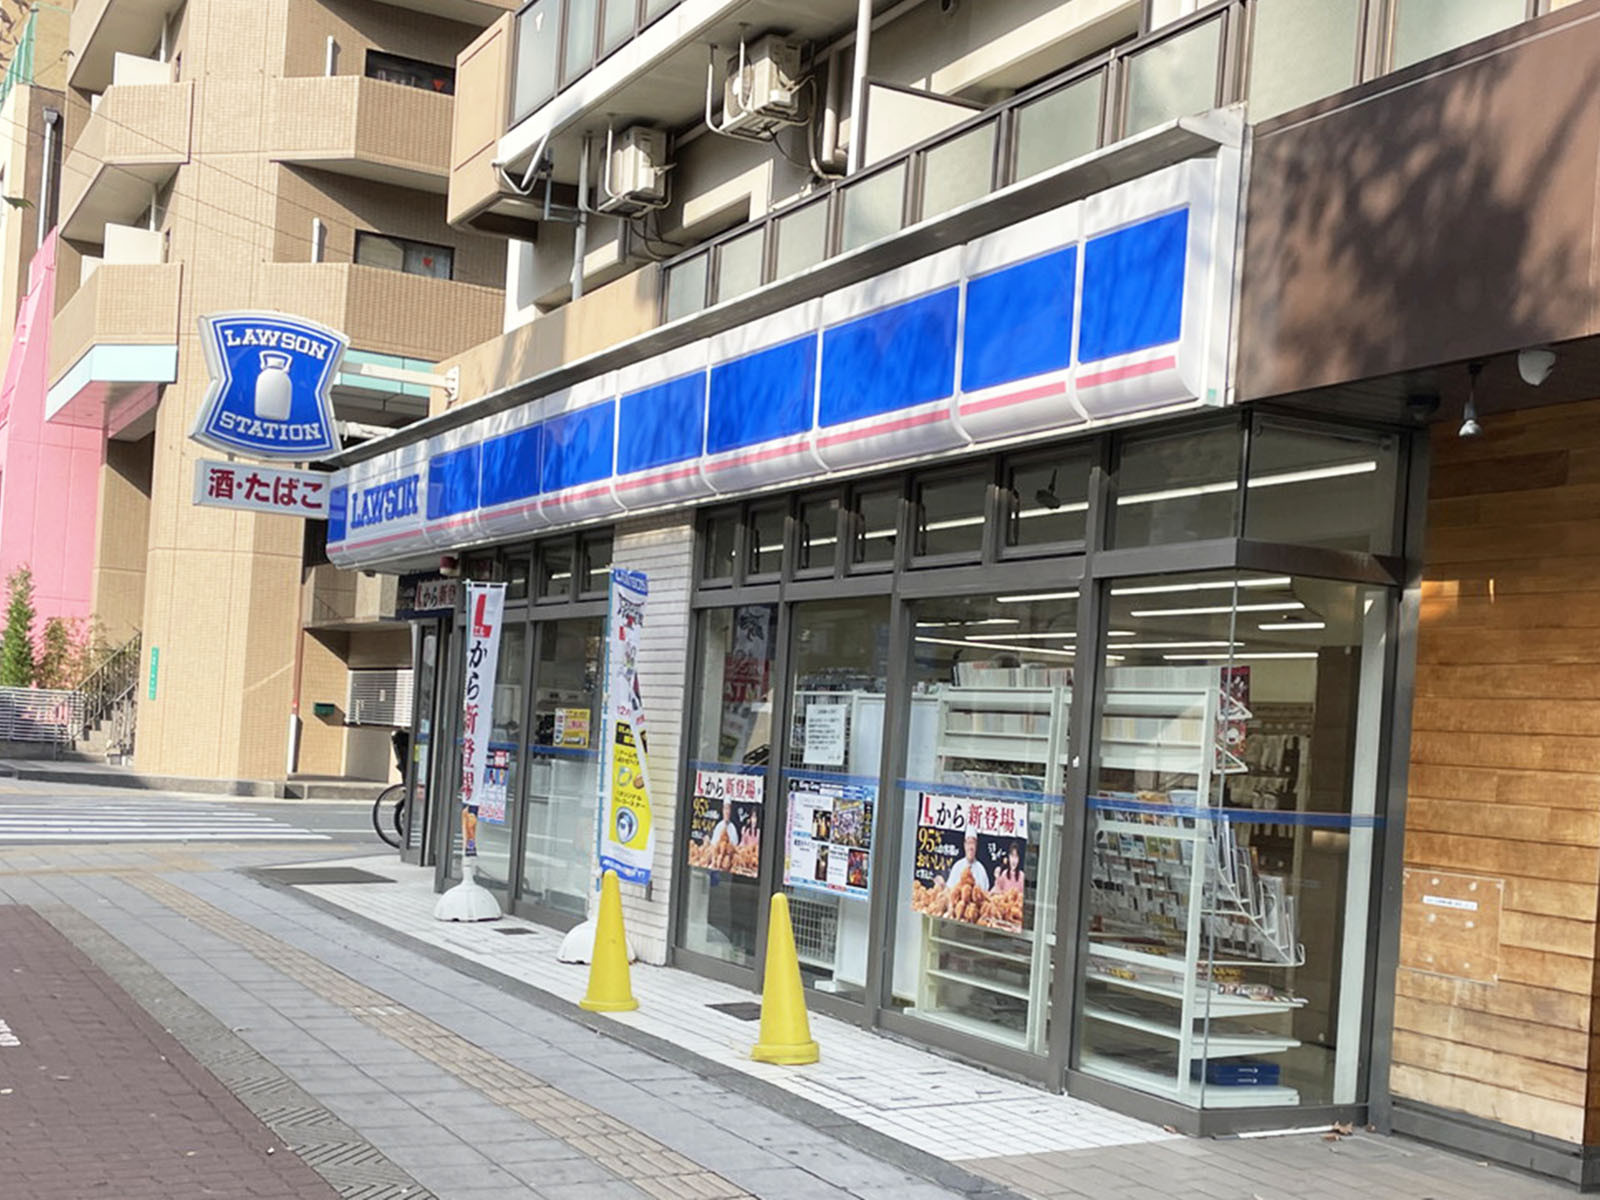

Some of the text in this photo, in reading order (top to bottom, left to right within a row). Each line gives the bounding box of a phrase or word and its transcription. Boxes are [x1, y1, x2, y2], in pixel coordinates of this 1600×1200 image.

[224, 328, 328, 360] LAWSON
[219, 410, 322, 441] STATION
[207, 467, 323, 510] 酒・たばこ
[350, 474, 420, 530] LAWSON
[923, 796, 1016, 834] Lから新登場
